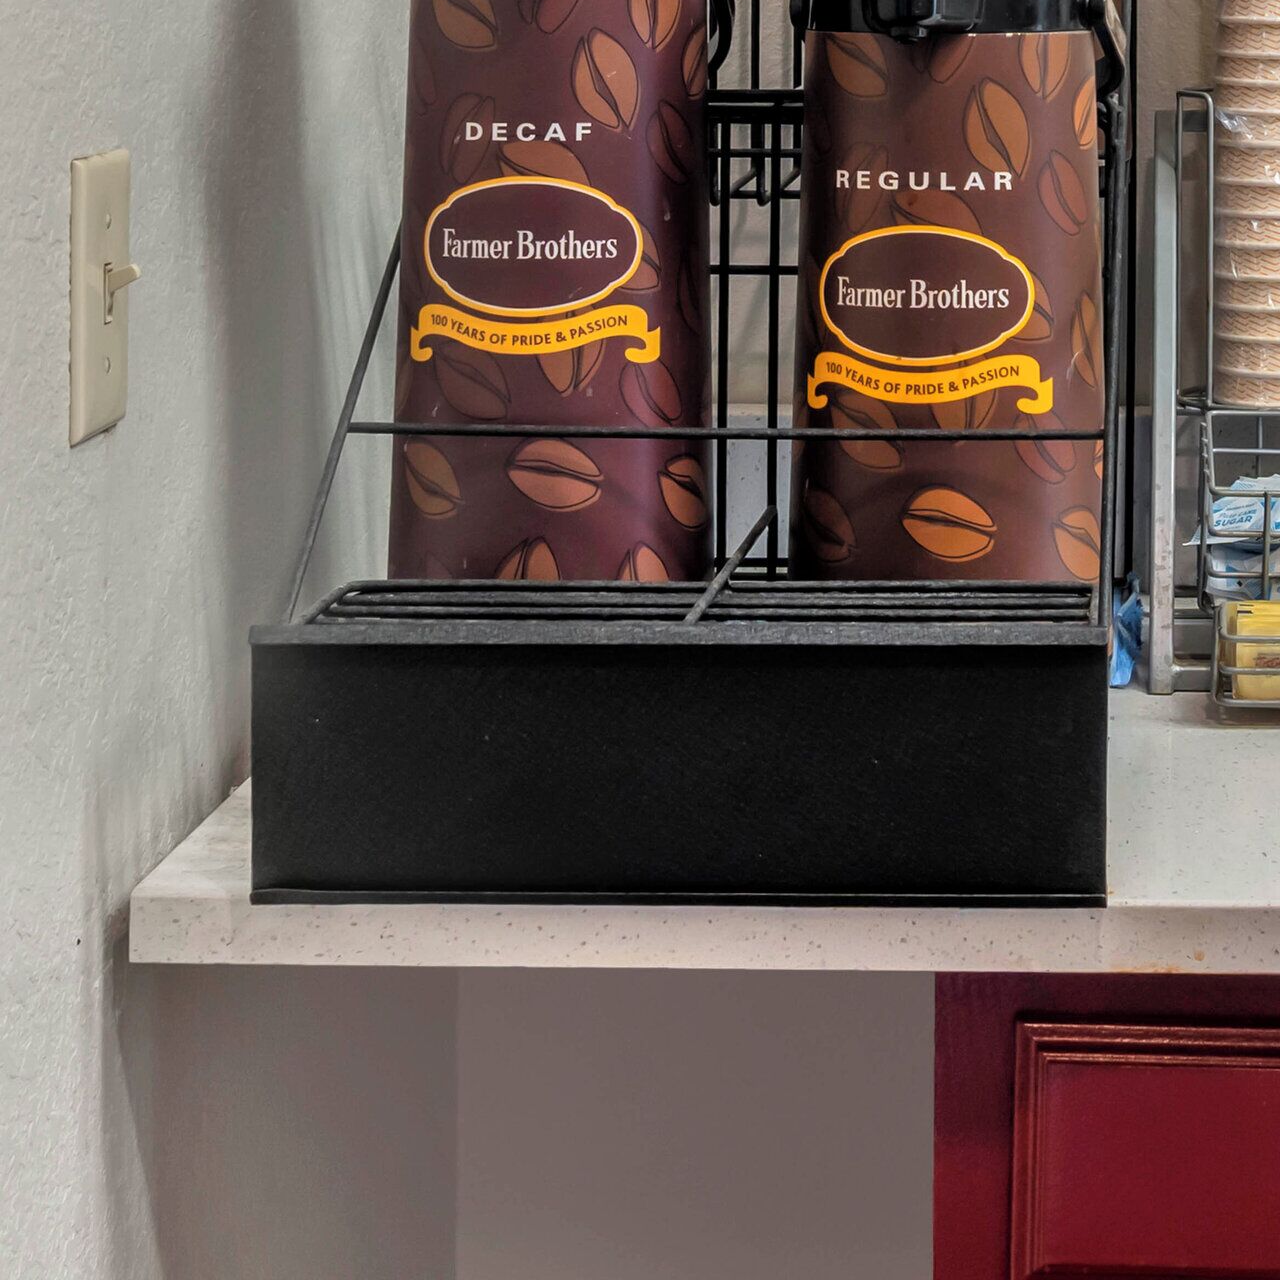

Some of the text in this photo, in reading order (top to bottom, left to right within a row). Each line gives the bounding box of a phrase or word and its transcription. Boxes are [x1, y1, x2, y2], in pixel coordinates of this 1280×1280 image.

[465, 122, 593, 142] DECAF
[835, 169, 1013, 191] REGULAR
[442, 227, 618, 260] Farmer Brothers
[836, 276, 1010, 309] Farmer Brothers
[430, 313, 629, 346] 100 YEARS OF PRIDE & PASSION
[825, 361, 1020, 396] 100 YEARS OF PRIDE & PASSION
[1213, 515, 1253, 527] SUGAR
